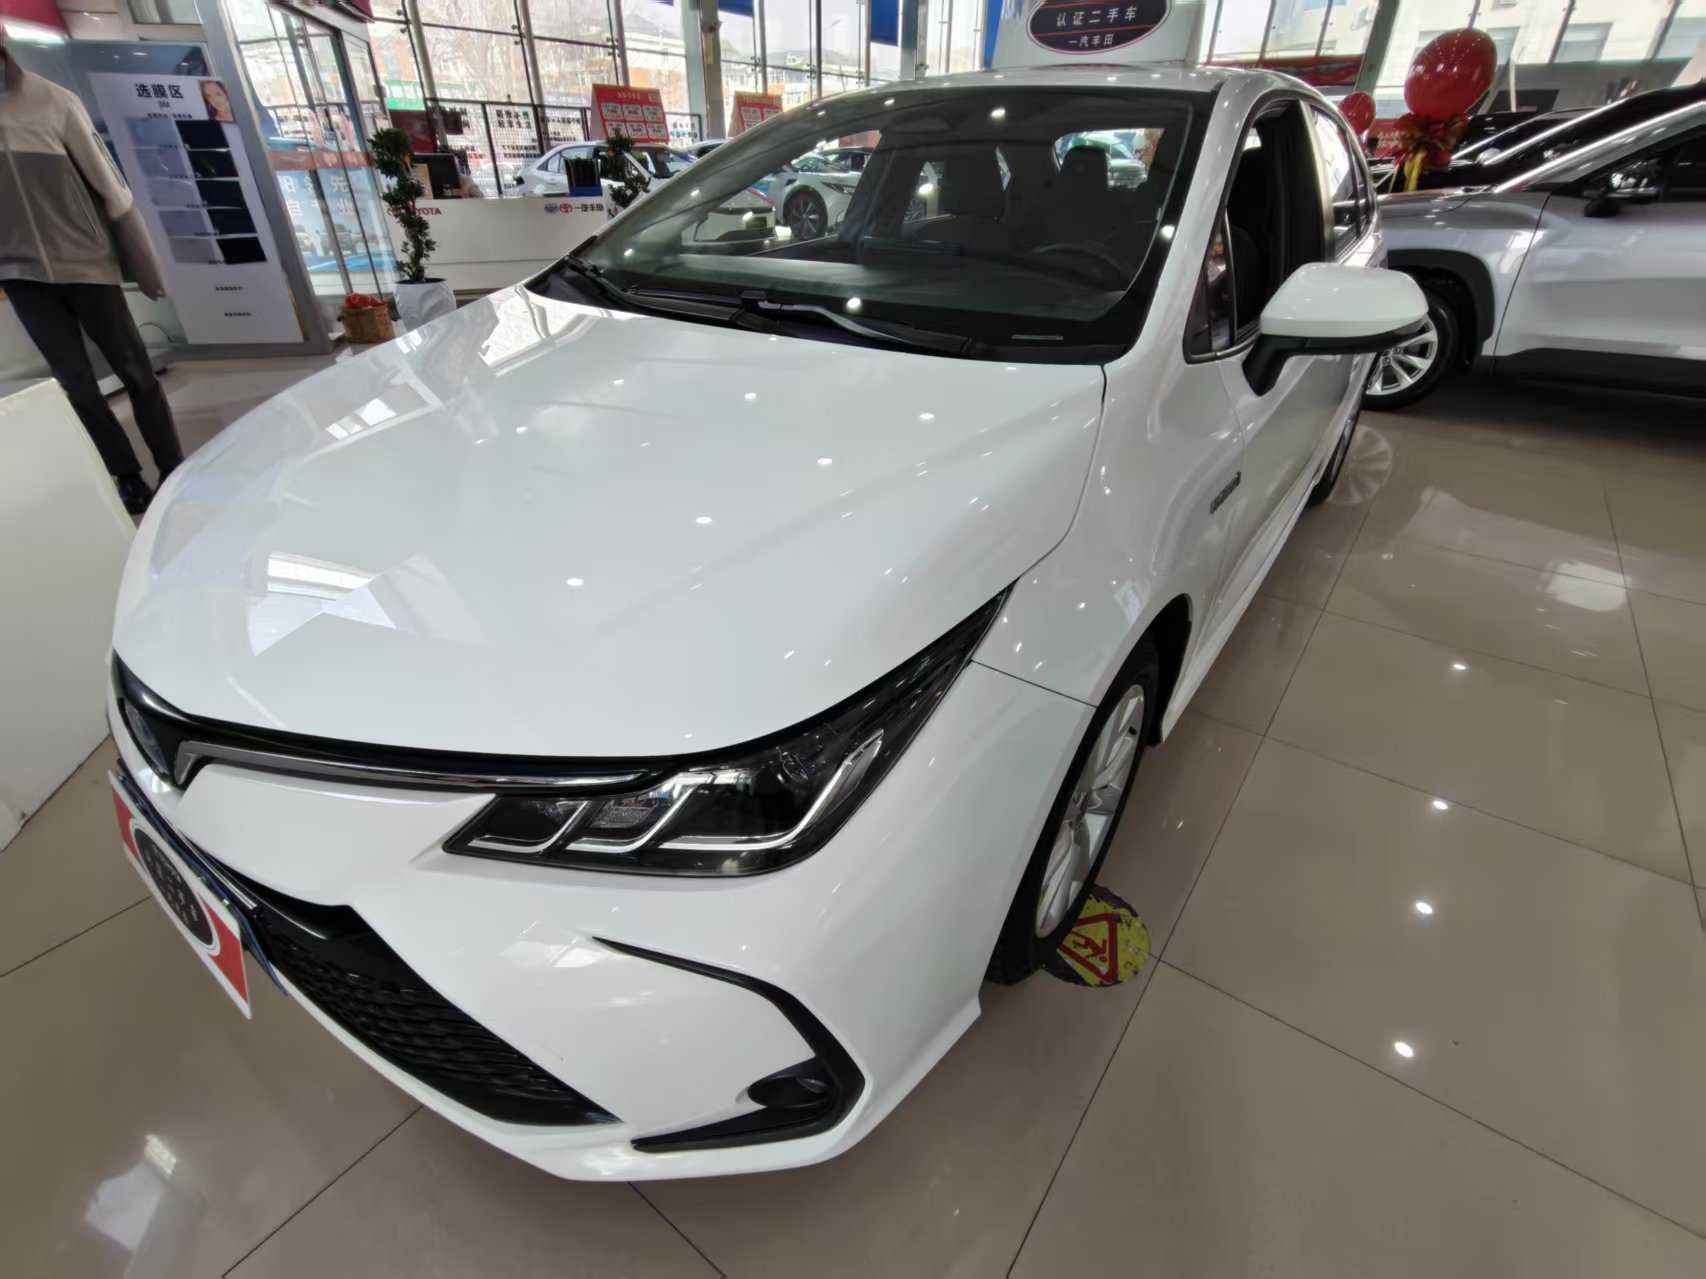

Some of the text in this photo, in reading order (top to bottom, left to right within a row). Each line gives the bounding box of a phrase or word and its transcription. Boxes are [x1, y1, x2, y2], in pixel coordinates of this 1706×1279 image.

[1056, 5, 1138, 27] 认证二手车
[135, 83, 184, 99] 选膜区
